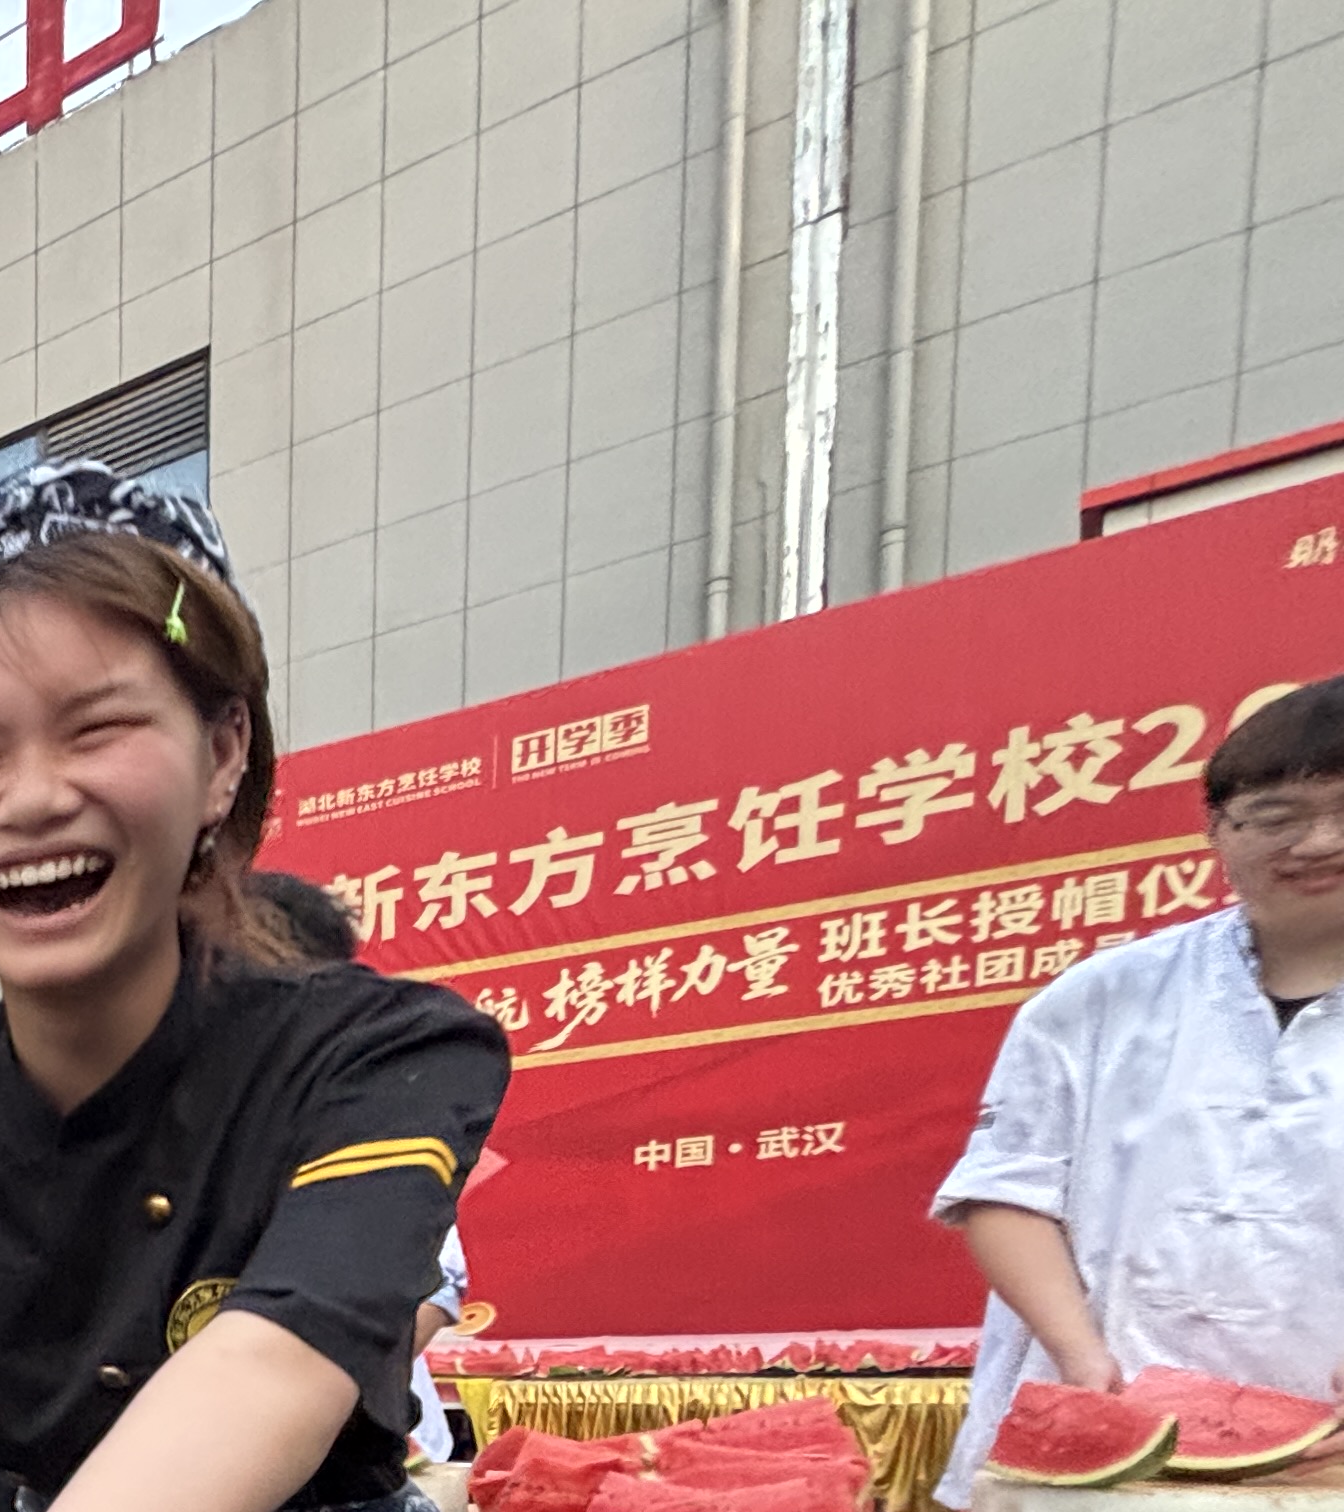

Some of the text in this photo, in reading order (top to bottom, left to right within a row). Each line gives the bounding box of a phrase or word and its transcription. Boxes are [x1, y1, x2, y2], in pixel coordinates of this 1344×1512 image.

[514, 707, 647, 771] 开学季
[298, 756, 482, 816] 湖北新东方烹饪学校
[325, 683, 1304, 942] 新东方烹饪学校2
[357, 800, 384, 815] EAST
[433, 778, 483, 797] SCHOOL
[528, 926, 800, 1053] 榜样力量
[817, 858, 1241, 963] 班长授帽仪
